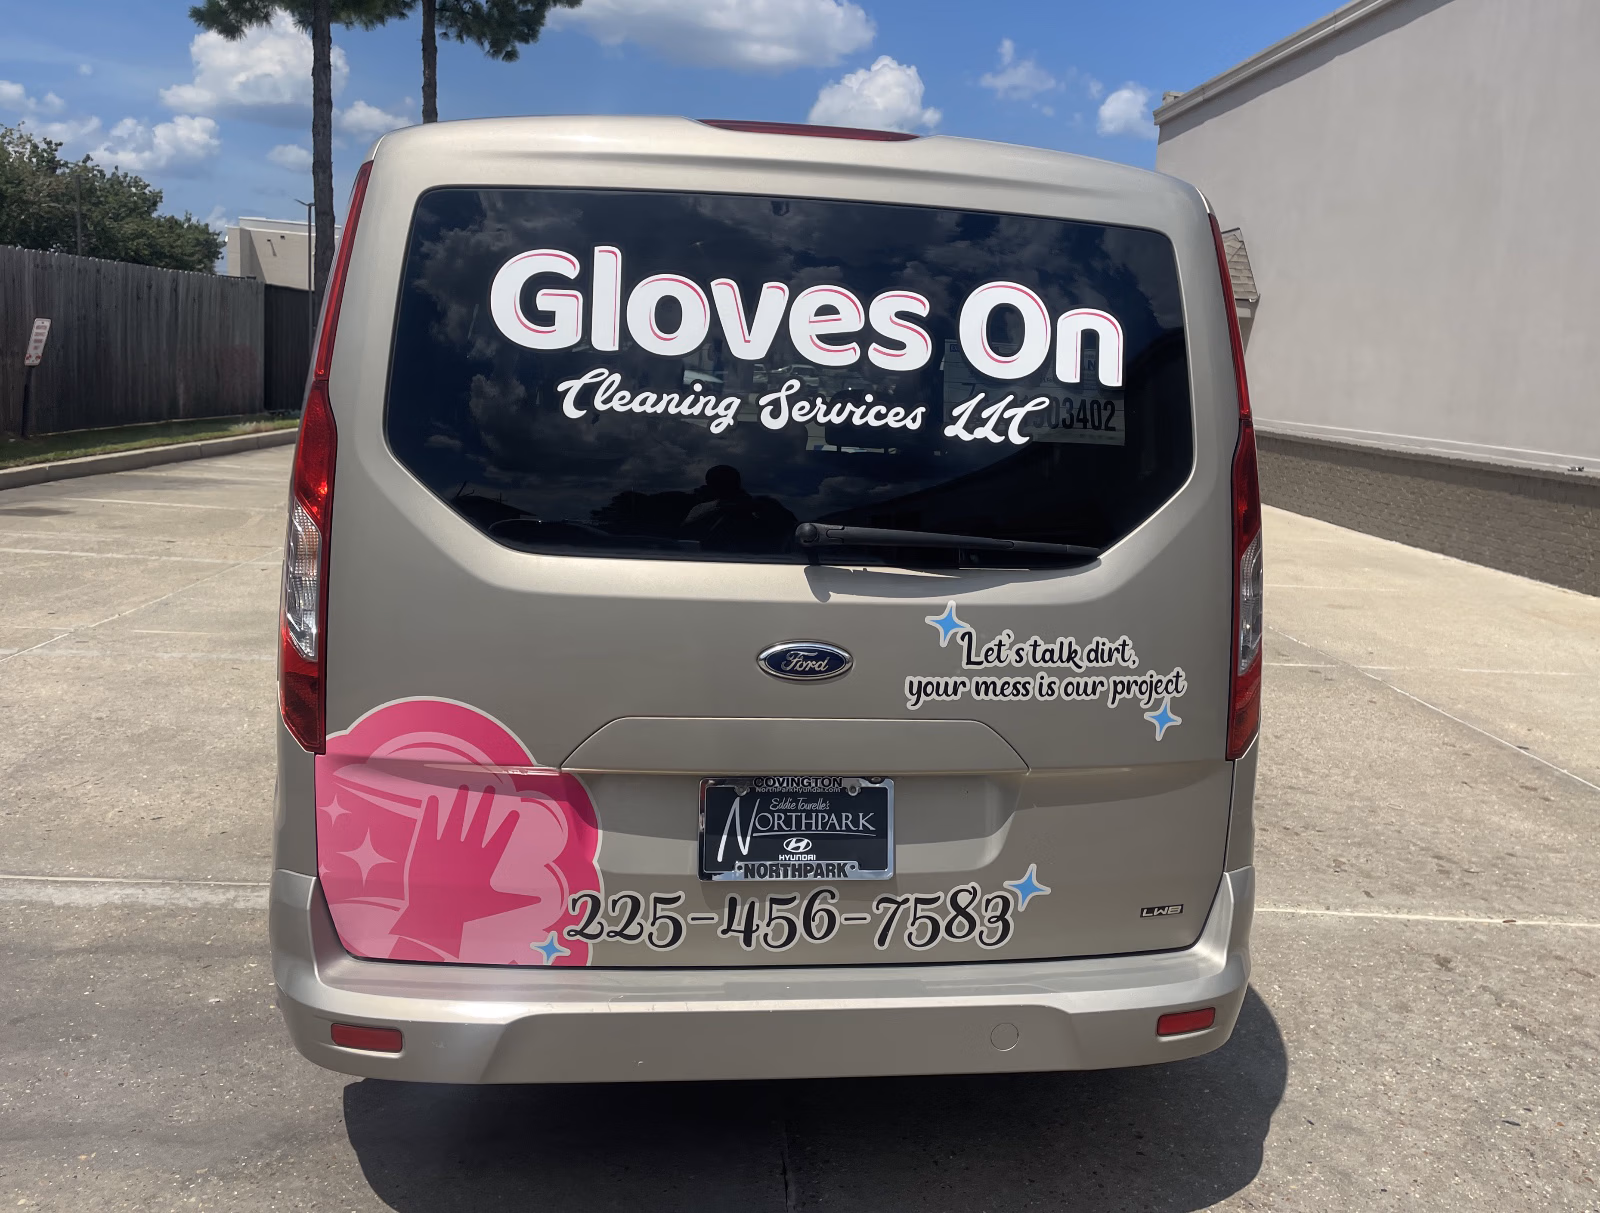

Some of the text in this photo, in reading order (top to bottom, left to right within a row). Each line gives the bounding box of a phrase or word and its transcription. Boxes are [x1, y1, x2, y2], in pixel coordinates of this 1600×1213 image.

[490, 245, 1124, 388] Gloves On
[556, 368, 1050, 445] Cleaning Services LLC
[1020, 395, 1117, 432] 03402
[780, 650, 831, 672] Ford
[960, 631, 1136, 669] Let's talk dirt,
[908, 669, 1185, 707] your mess is our project
[753, 776, 844, 788] COVINGTON
[769, 797, 797, 811] Eddie
[717, 796, 876, 862] NORTHPARK
[743, 863, 849, 879] NORTHPARK
[778, 853, 817, 861] HYUNDAI
[566, 886, 1014, 948] 225-456-7583
[1142, 905, 1182, 917] LWB
